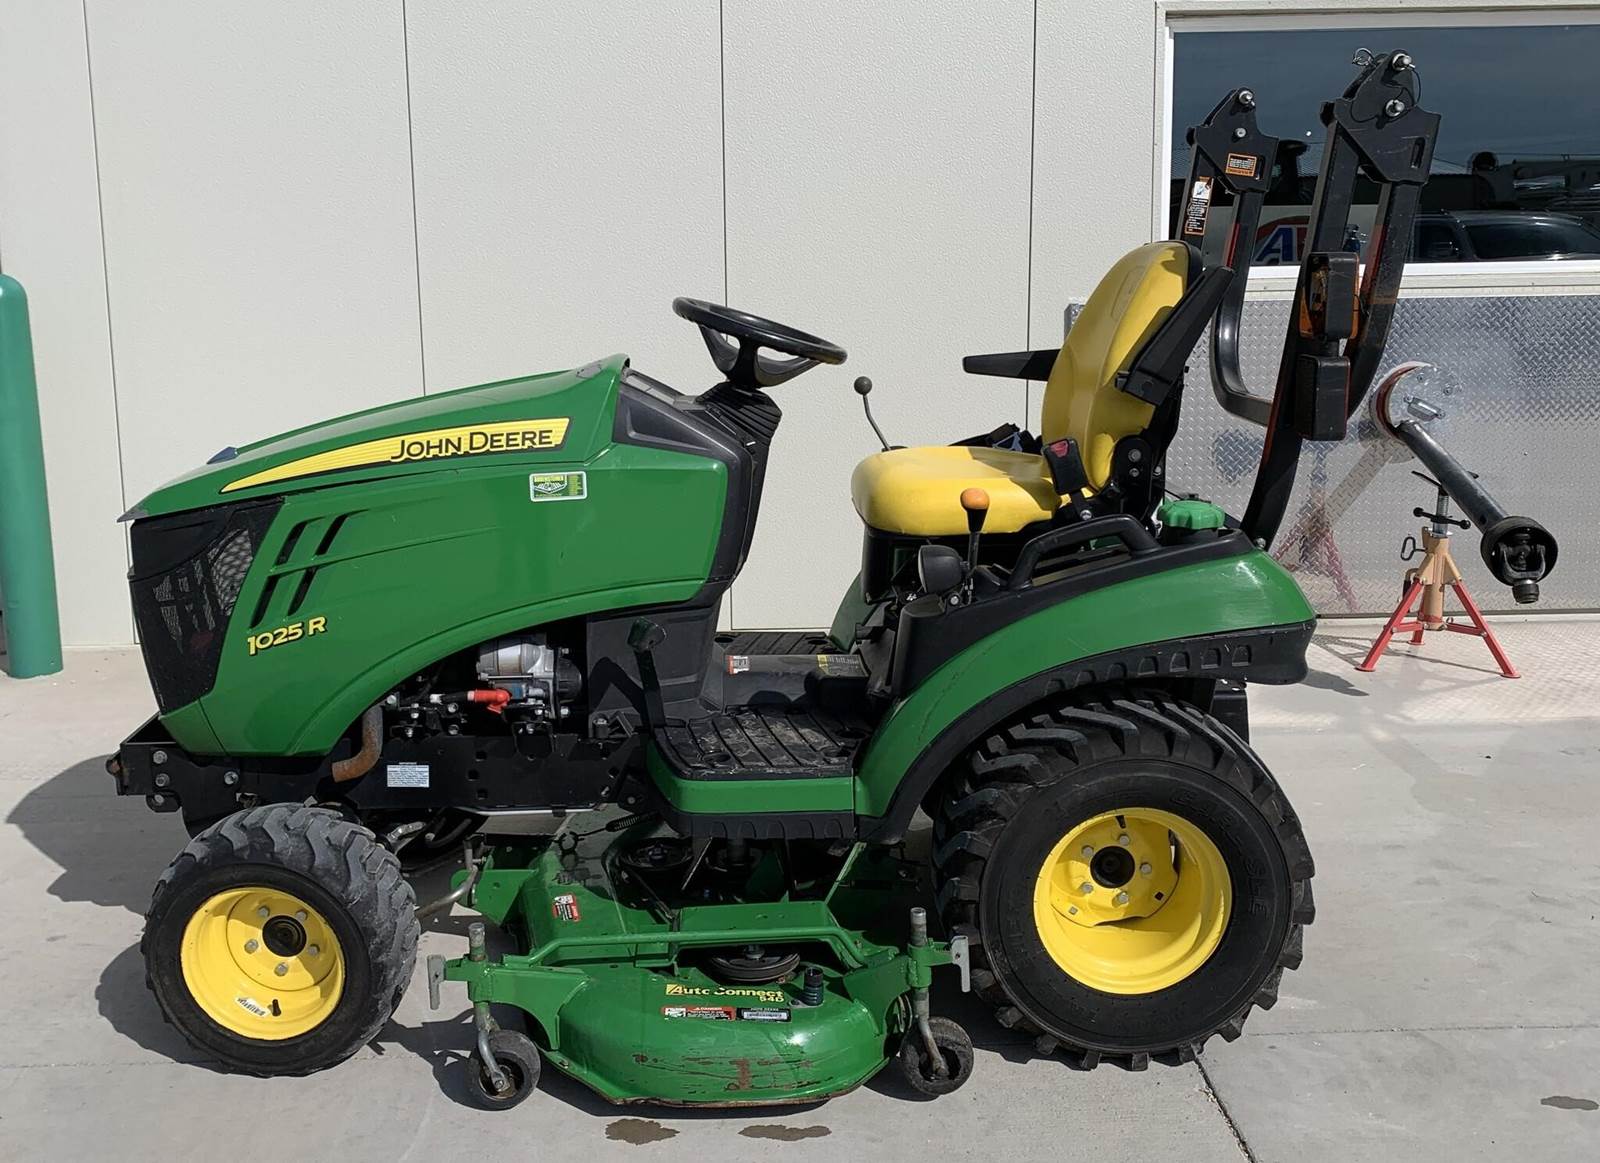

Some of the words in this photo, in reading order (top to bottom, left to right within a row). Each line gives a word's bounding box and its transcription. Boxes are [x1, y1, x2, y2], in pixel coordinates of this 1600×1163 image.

[391, 436, 462, 460] JOHN
[469, 429, 553, 451] DEERE
[247, 622, 304, 655] 1025
[308, 616, 326, 635] R
